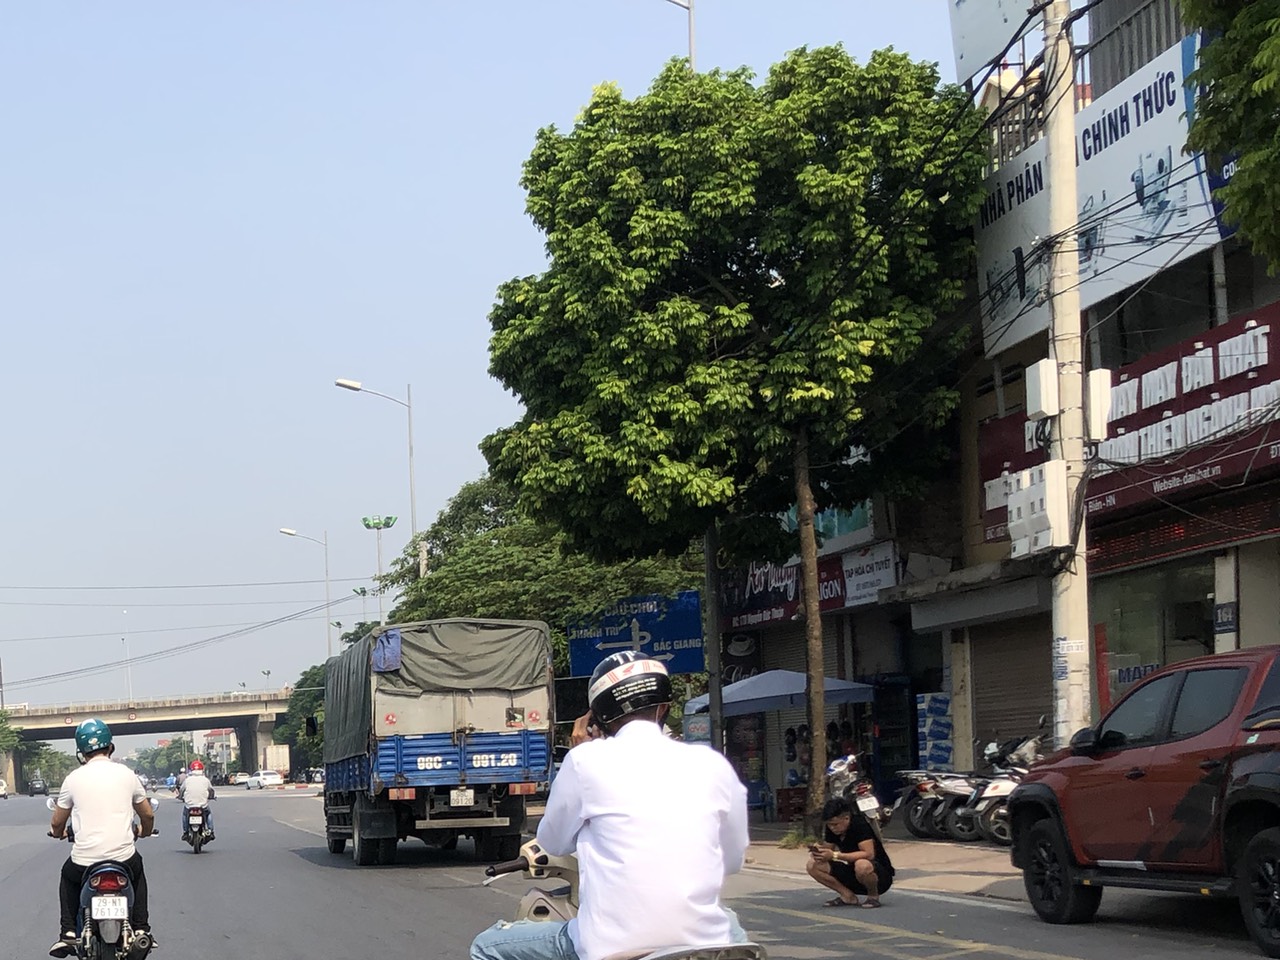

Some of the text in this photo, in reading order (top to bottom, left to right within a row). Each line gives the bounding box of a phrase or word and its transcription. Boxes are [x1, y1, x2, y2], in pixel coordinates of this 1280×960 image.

[1007, 162, 1044, 212] PHÂN
[1082, 108, 1131, 161] CHÍNH
[1135, 70, 1177, 128] THỨC
[674, 638, 701, 650] GIANG
